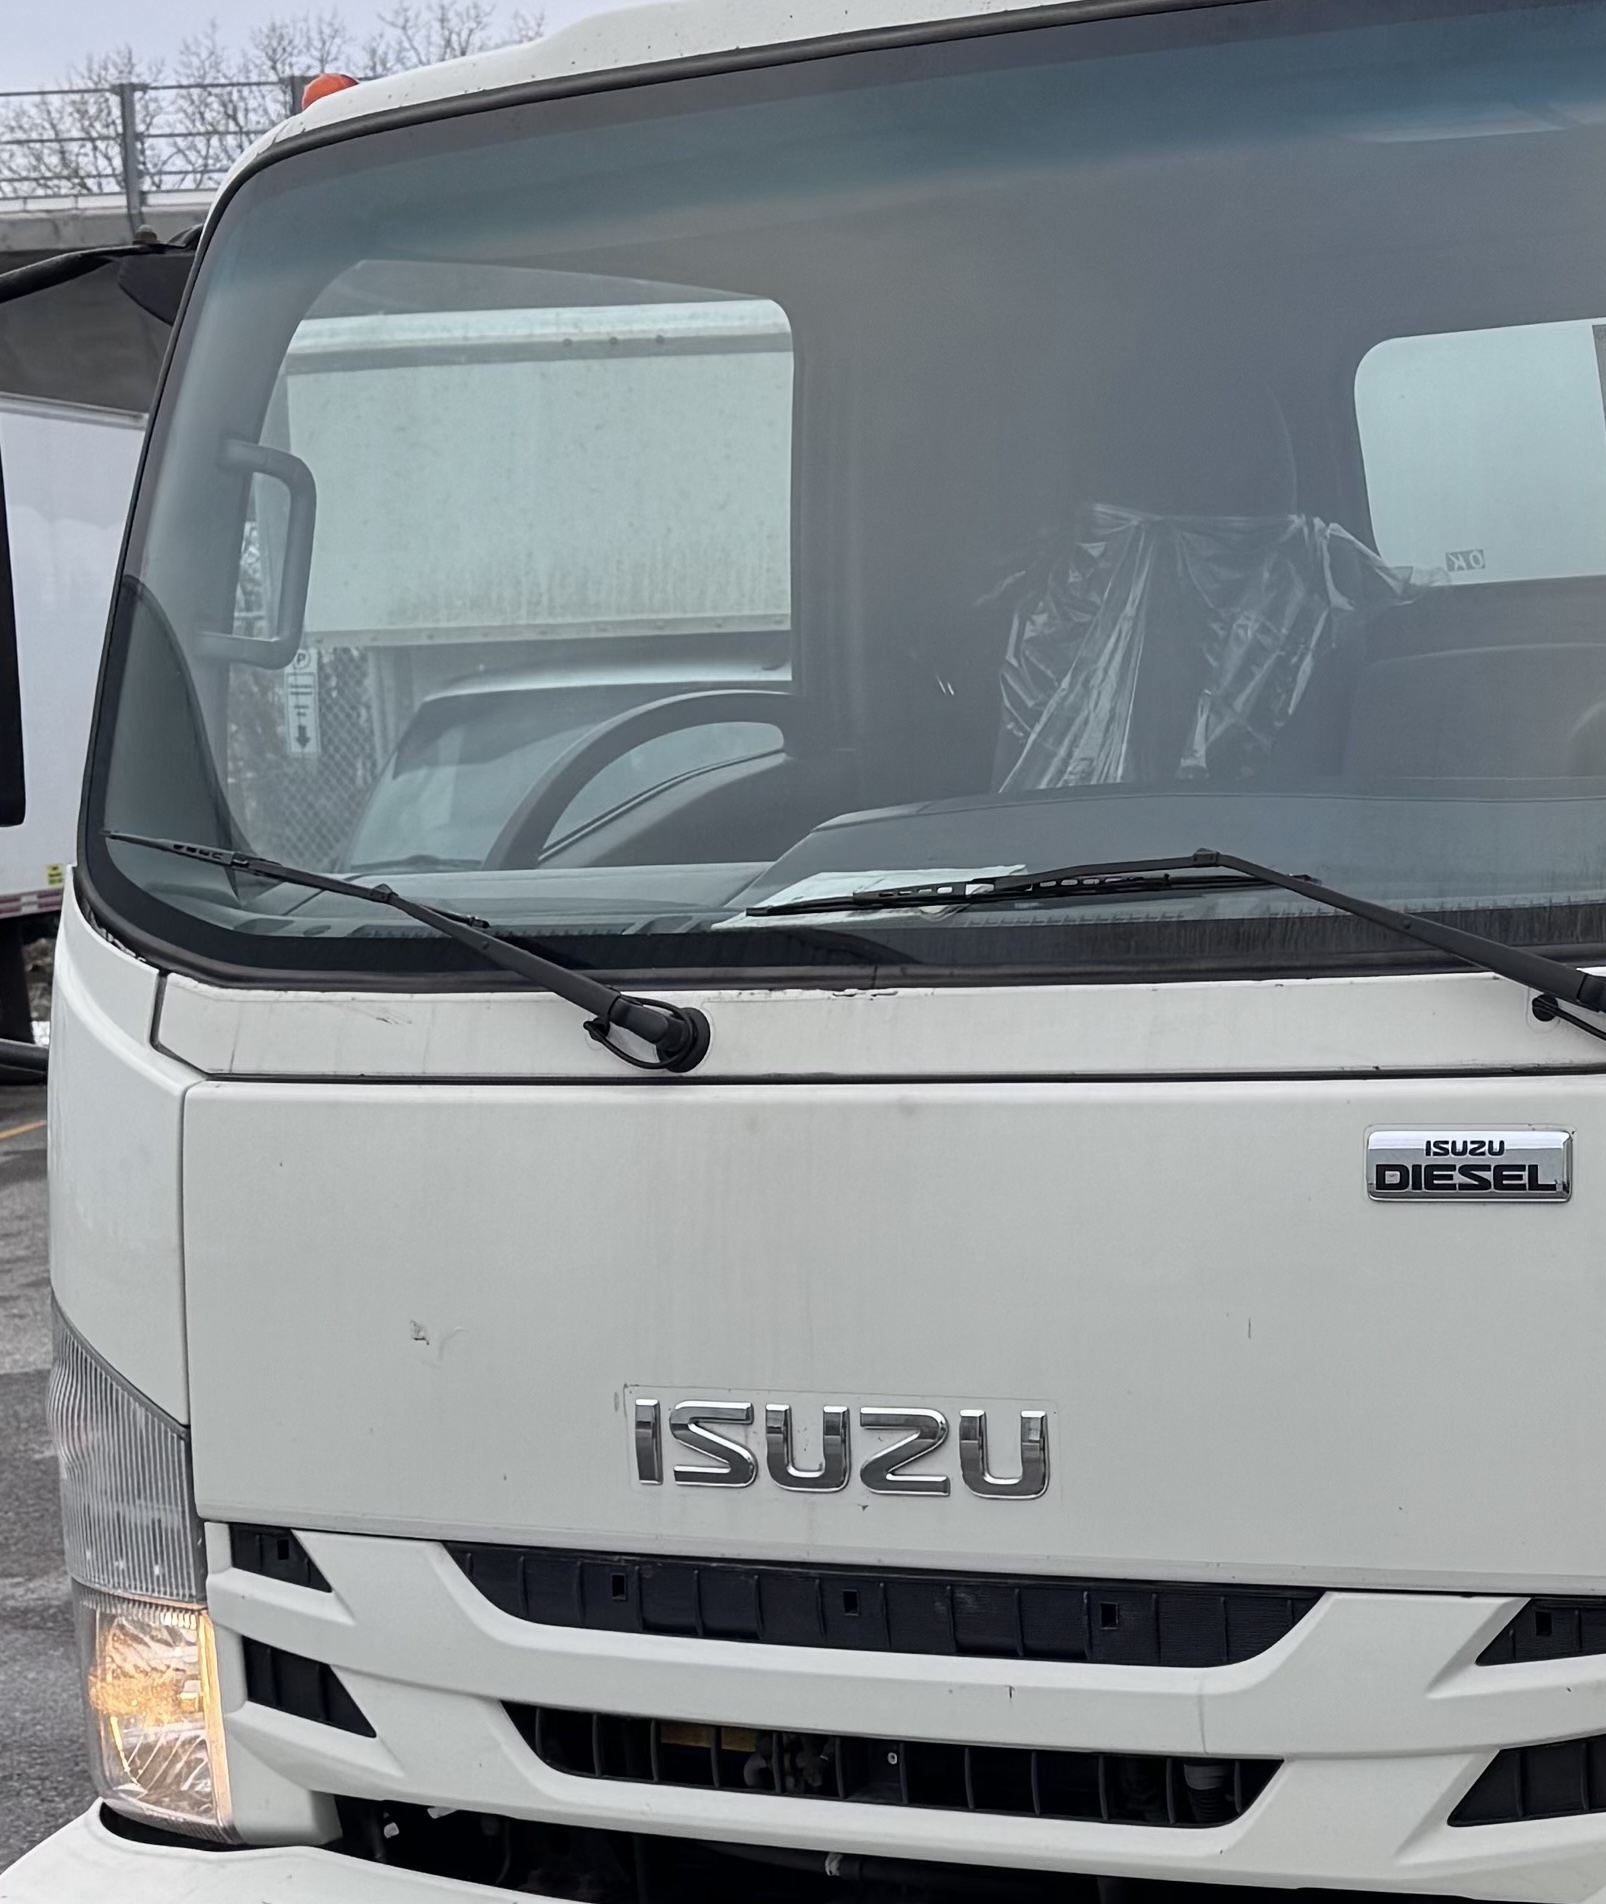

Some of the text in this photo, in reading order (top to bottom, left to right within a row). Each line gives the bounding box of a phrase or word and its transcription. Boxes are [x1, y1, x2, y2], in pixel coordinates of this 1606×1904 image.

[1425, 1140, 1505, 1157] ISUZU
[1375, 1164, 1557, 1191] DIESEL
[635, 1399, 1050, 1500] ISUZU
